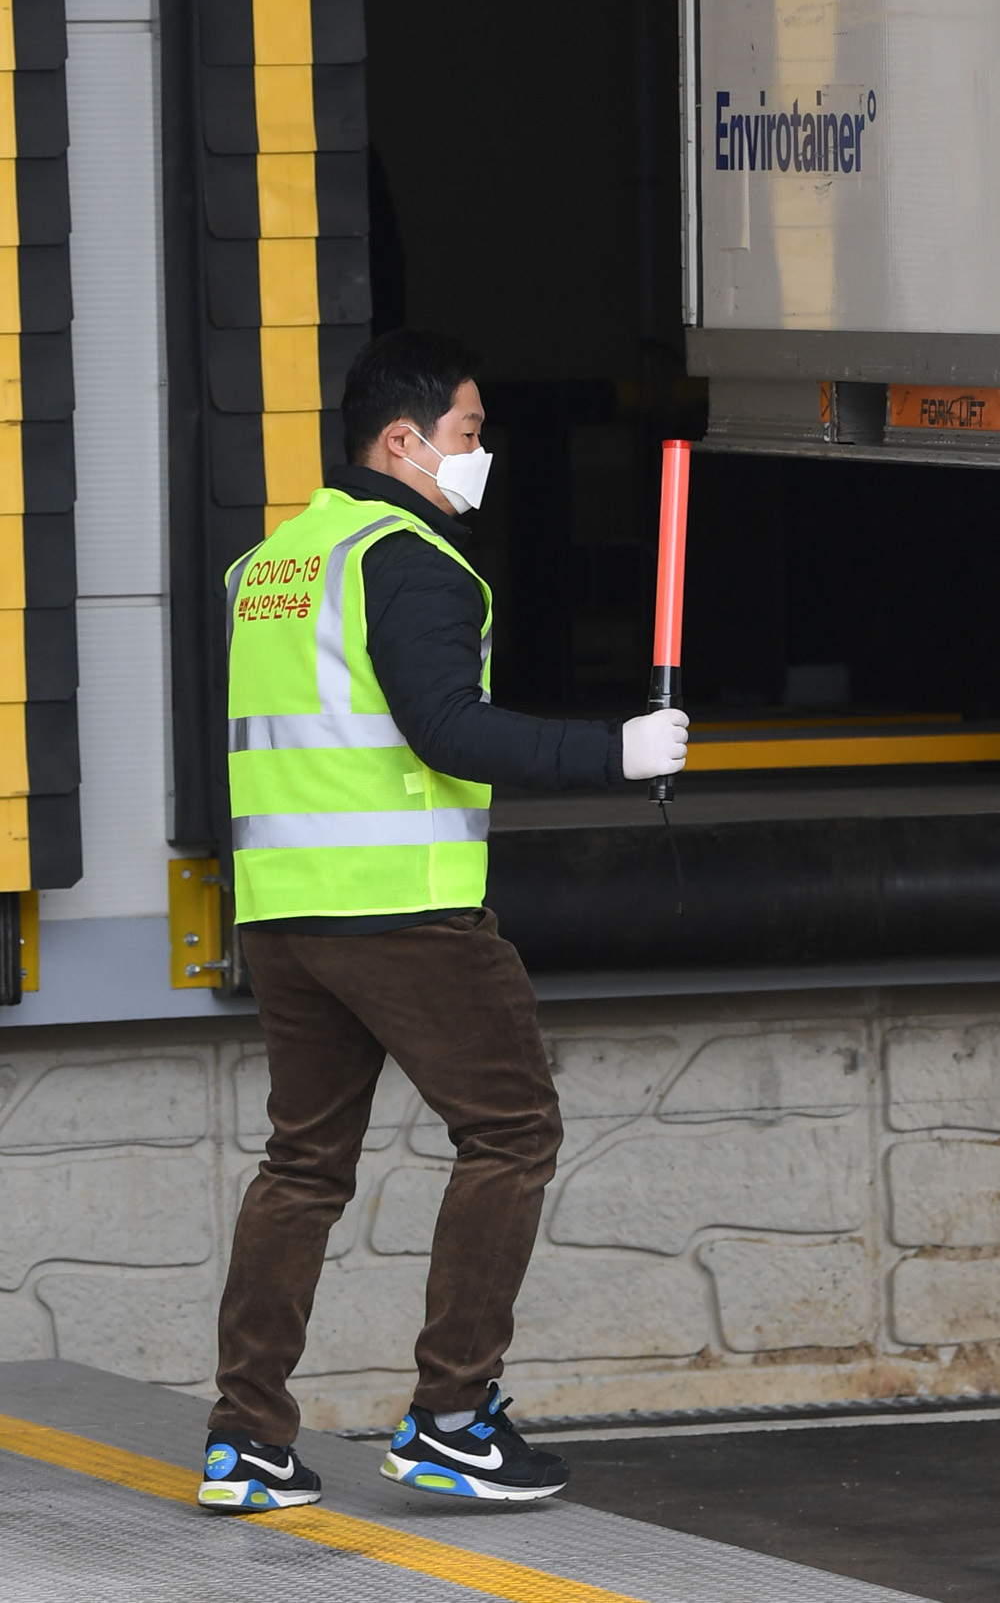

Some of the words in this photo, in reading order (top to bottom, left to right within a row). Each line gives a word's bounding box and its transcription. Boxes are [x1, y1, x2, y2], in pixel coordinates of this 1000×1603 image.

[920, 398, 954, 426] FORK
[959, 399, 985, 427] LIFT
[246, 555, 321, 587] COVID-19
[238, 591, 311, 623] 백신안전수송
